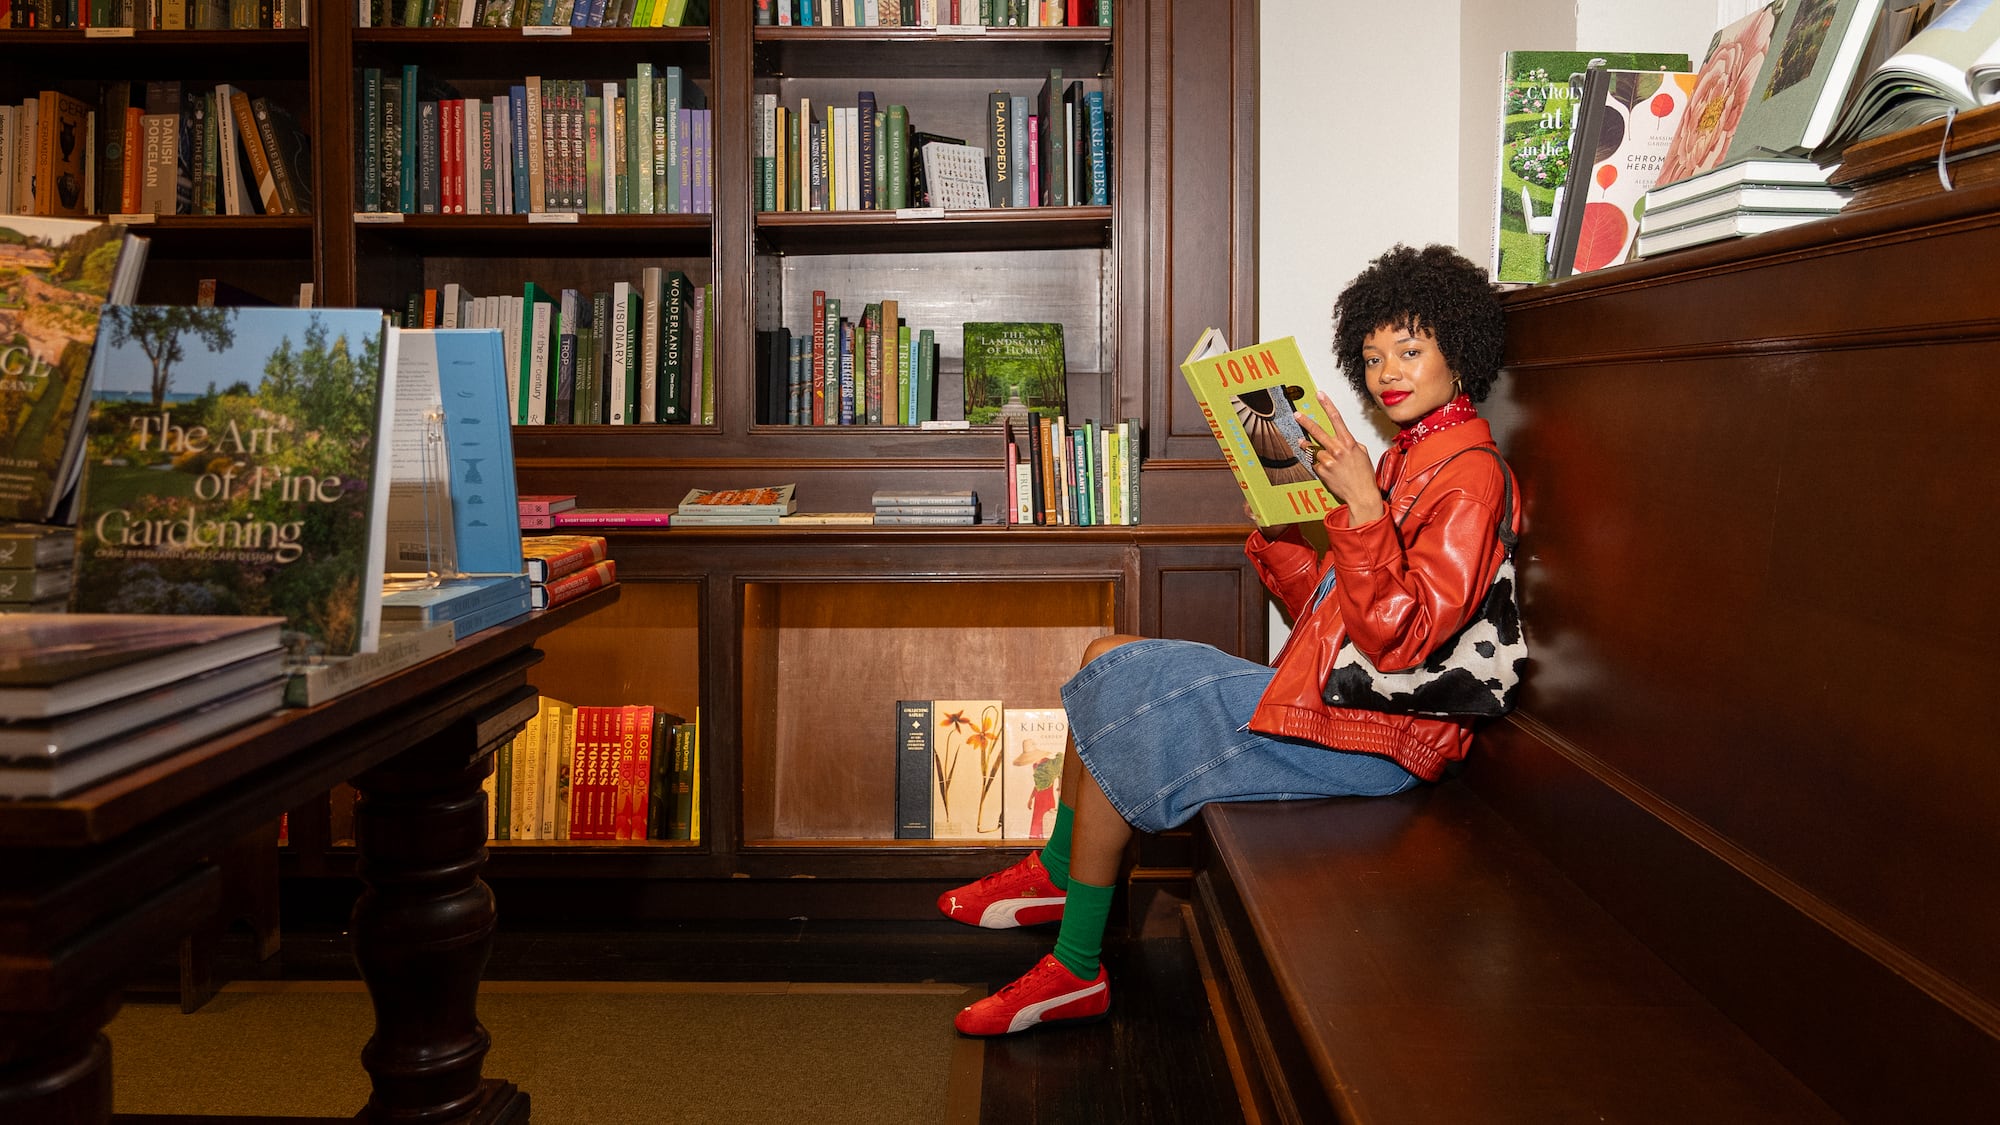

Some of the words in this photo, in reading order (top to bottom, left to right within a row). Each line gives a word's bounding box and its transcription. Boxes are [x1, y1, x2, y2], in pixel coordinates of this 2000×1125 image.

[669, 97, 677, 111] The
[1526, 86, 1584, 100] CAROLY
[385, 102, 394, 143] ENGLISH
[442, 106, 450, 128] Everyday
[454, 105, 462, 128] Everyday
[527, 87, 538, 141] LANDSCAPE
[546, 113, 556, 139] forever
[560, 113, 570, 139] forever
[574, 114, 584, 139] forever
[669, 112, 677, 139] Modern
[1091, 105, 1104, 148] RARE
[1539, 107, 1564, 130] at
[40, 120, 48, 167] CERAMICS
[161, 118, 173, 165] DANISH
[195, 124, 203, 153] EARTH
[238, 111, 254, 138] STUDIO
[247, 139, 264, 177] CERAMICS
[481, 119, 493, 171] GARDENS
[655, 116, 665, 151] GARDEN
[892, 131, 900, 148] WHO
[996, 101, 1007, 183] PLANTOPEDIA
[147, 119, 159, 188] PORCELAIN
[262, 123, 276, 152] EARTH
[273, 160, 284, 180] FIRE
[529, 142, 540, 176] DESIGN
[546, 140, 556, 158] paris
[560, 140, 570, 158] paris
[574, 140, 584, 158] paris
[669, 140, 677, 167] Garden
[892, 149, 900, 174] CARES
[1626, 154, 1665, 163] CHROM
[194, 162, 202, 182] FIRE
[367, 156, 376, 195] GARDENS
[384, 144, 393, 188] GARDENS
[655, 154, 665, 176] WILD
[681, 159, 690, 186] Garden
[694, 160, 703, 187] Garden
[878, 154, 886, 182] Oaklore
[1093, 149, 1106, 195] TREES
[1626, 163, 1660, 171] HERBA
[422, 167, 430, 191] GUIDE
[765, 159, 774, 209] WILDERNESS
[695, 295, 703, 308] The
[537, 307, 546, 328] parks
[646, 300, 657, 340] WINTER
[668, 277, 681, 366] WONDERLANDS
[826, 313, 837, 331] the
[539, 330, 546, 339] of
[615, 300, 626, 365] VISIONARY
[814, 320, 824, 349] TREE
[827, 333, 837, 355] tree
[981, 336, 1046, 346] LANDSCAPE
[1002, 331, 1025, 339] THE
[538, 340, 546, 354] the
[694, 334, 702, 360] Garden
[870, 334, 879, 359] forever
[884, 336, 896, 376] Trees
[986, 347, 1002, 355] OF
[1006, 346, 1041, 355] HOME
[645, 342, 656, 390] GARDENS
[814, 352, 824, 388] ATLAS
[826, 356, 837, 386] book
[841, 353, 854, 398] TREEKEEPERS
[870, 359, 879, 377] paris
[899, 343, 909, 385] TREES
[1214, 350, 1281, 388] JOHN
[533, 368, 543, 400] century
[856, 381, 865, 405] TREES
[130, 412, 208, 454] The
[215, 421, 280, 455] Art
[1131, 438, 1139, 454] JANE
[1199, 402, 1225, 440] JOHN
[1222, 448, 1241, 472] IKE
[194, 461, 247, 501] of
[253, 464, 343, 503] Fine
[1078, 469, 1086, 494] PLANTS
[1131, 455, 1139, 484] AUSTEN'S
[1020, 472, 1029, 503] FRUIT
[1131, 485, 1139, 512] GARDEN
[1287, 487, 1333, 516] IKE
[95, 508, 306, 564] Gardening
[126, 550, 179, 559] BERGMANN
[181, 551, 236, 560] LANDSCAPE
[238, 552, 273, 561] DESIGN
[625, 712, 634, 731] THE
[640, 712, 650, 731] THE
[1020, 722, 1065, 732] KINFO
[623, 734, 633, 761] ROSE
[639, 734, 649, 761] ROSE
[575, 742, 586, 786] roses
[587, 742, 598, 786] roses
[599, 742, 610, 786] roses
[610, 742, 622, 786] roses
[621, 763, 631, 795] BOOK
[636, 763, 647, 795] BOOK
